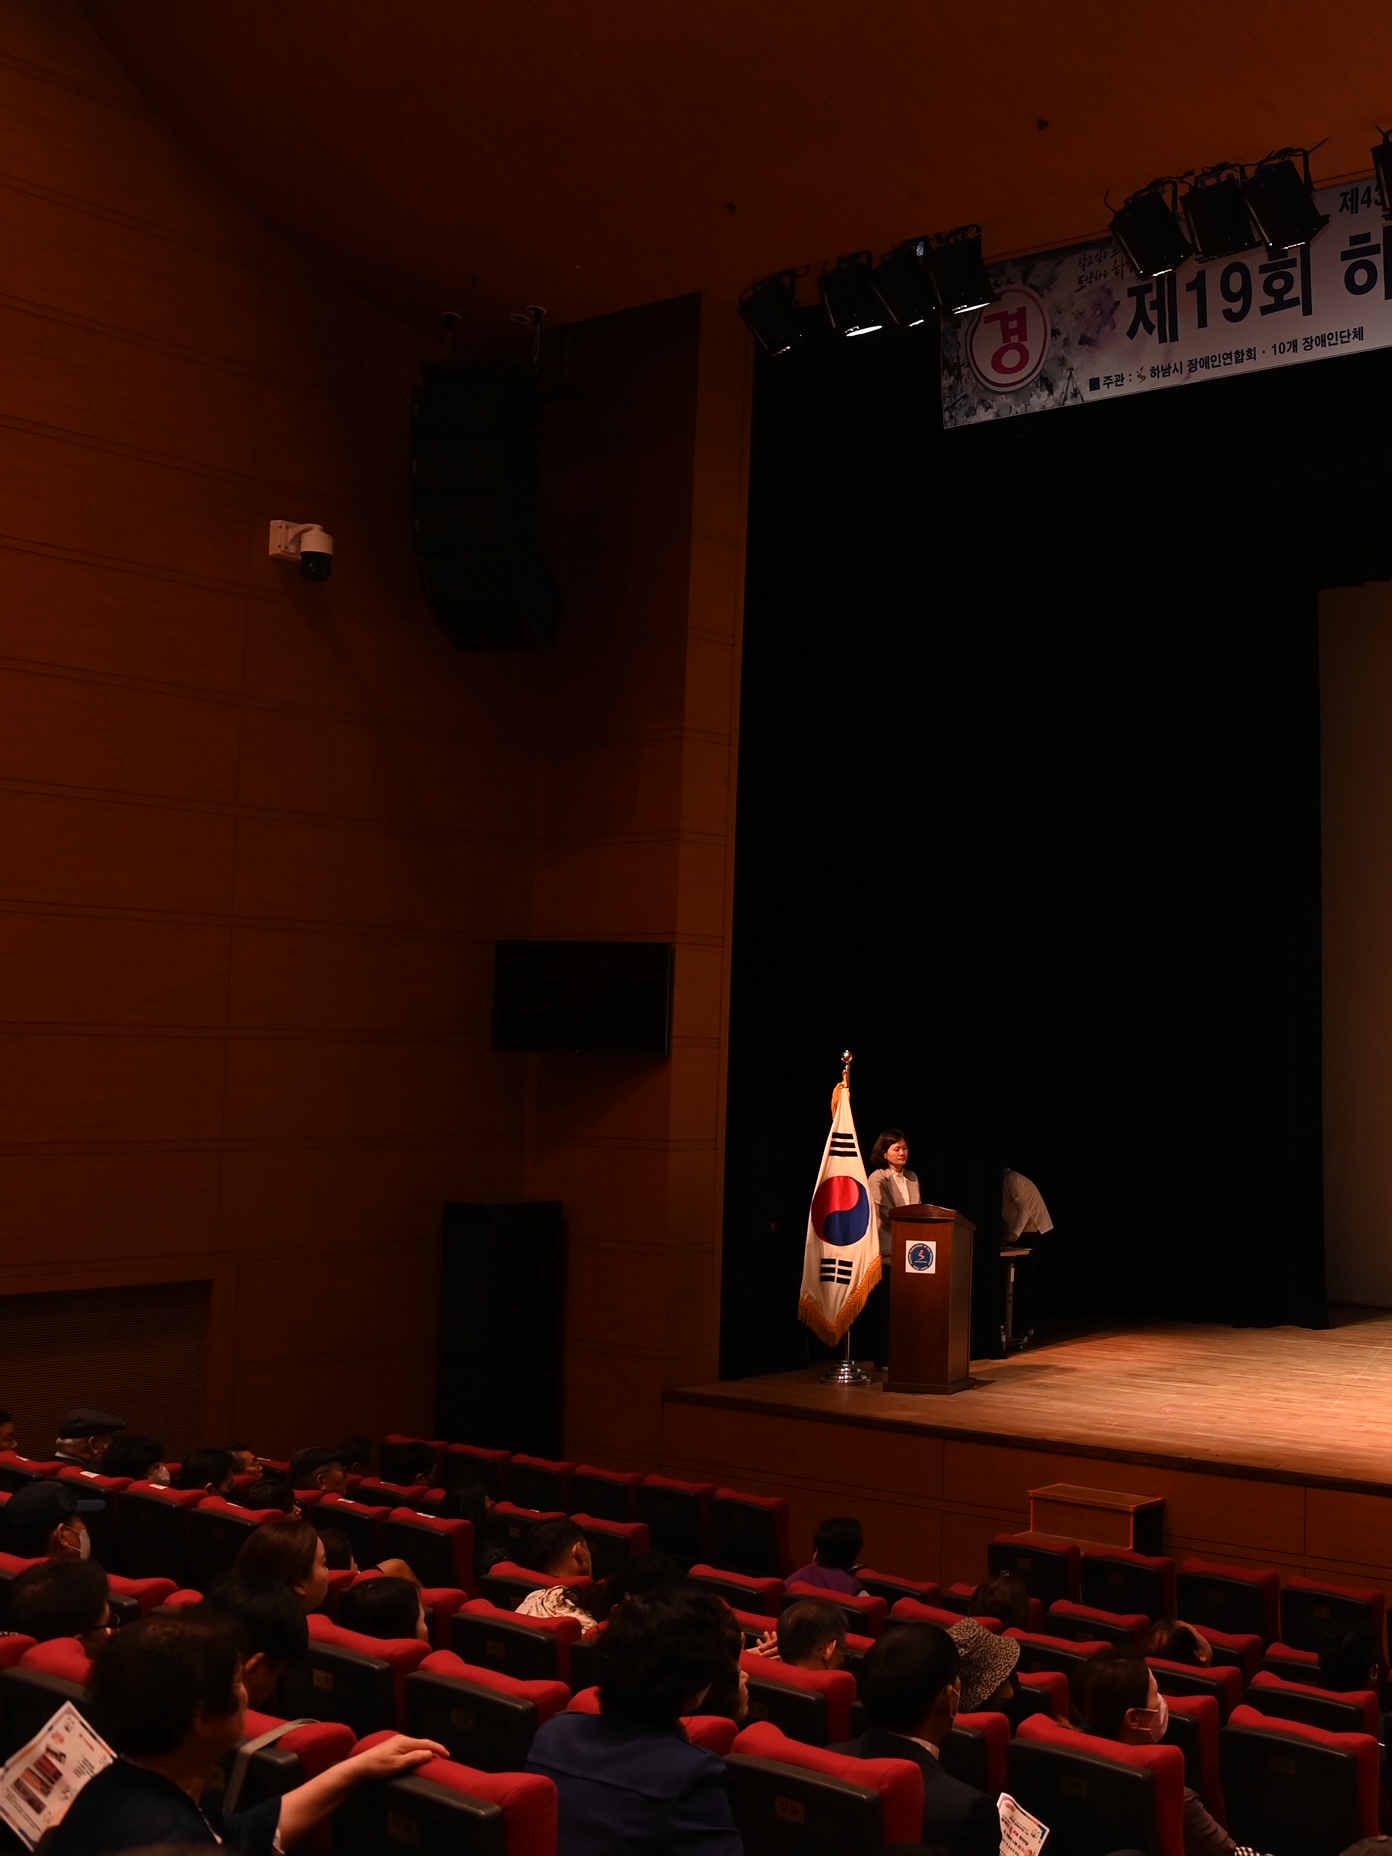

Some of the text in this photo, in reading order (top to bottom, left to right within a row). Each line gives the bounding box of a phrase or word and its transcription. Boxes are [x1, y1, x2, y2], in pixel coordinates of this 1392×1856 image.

[1126, 241, 1312, 344] 제19회
[984, 306, 1030, 375] 경
[1102, 372, 1125, 389] 주관
[1149, 360, 1183, 379] 하남시
[1187, 346, 1257, 373] 장애인연합회
[1272, 339, 1298, 356] 10개
[1302, 326, 1365, 351] 장애인단체
